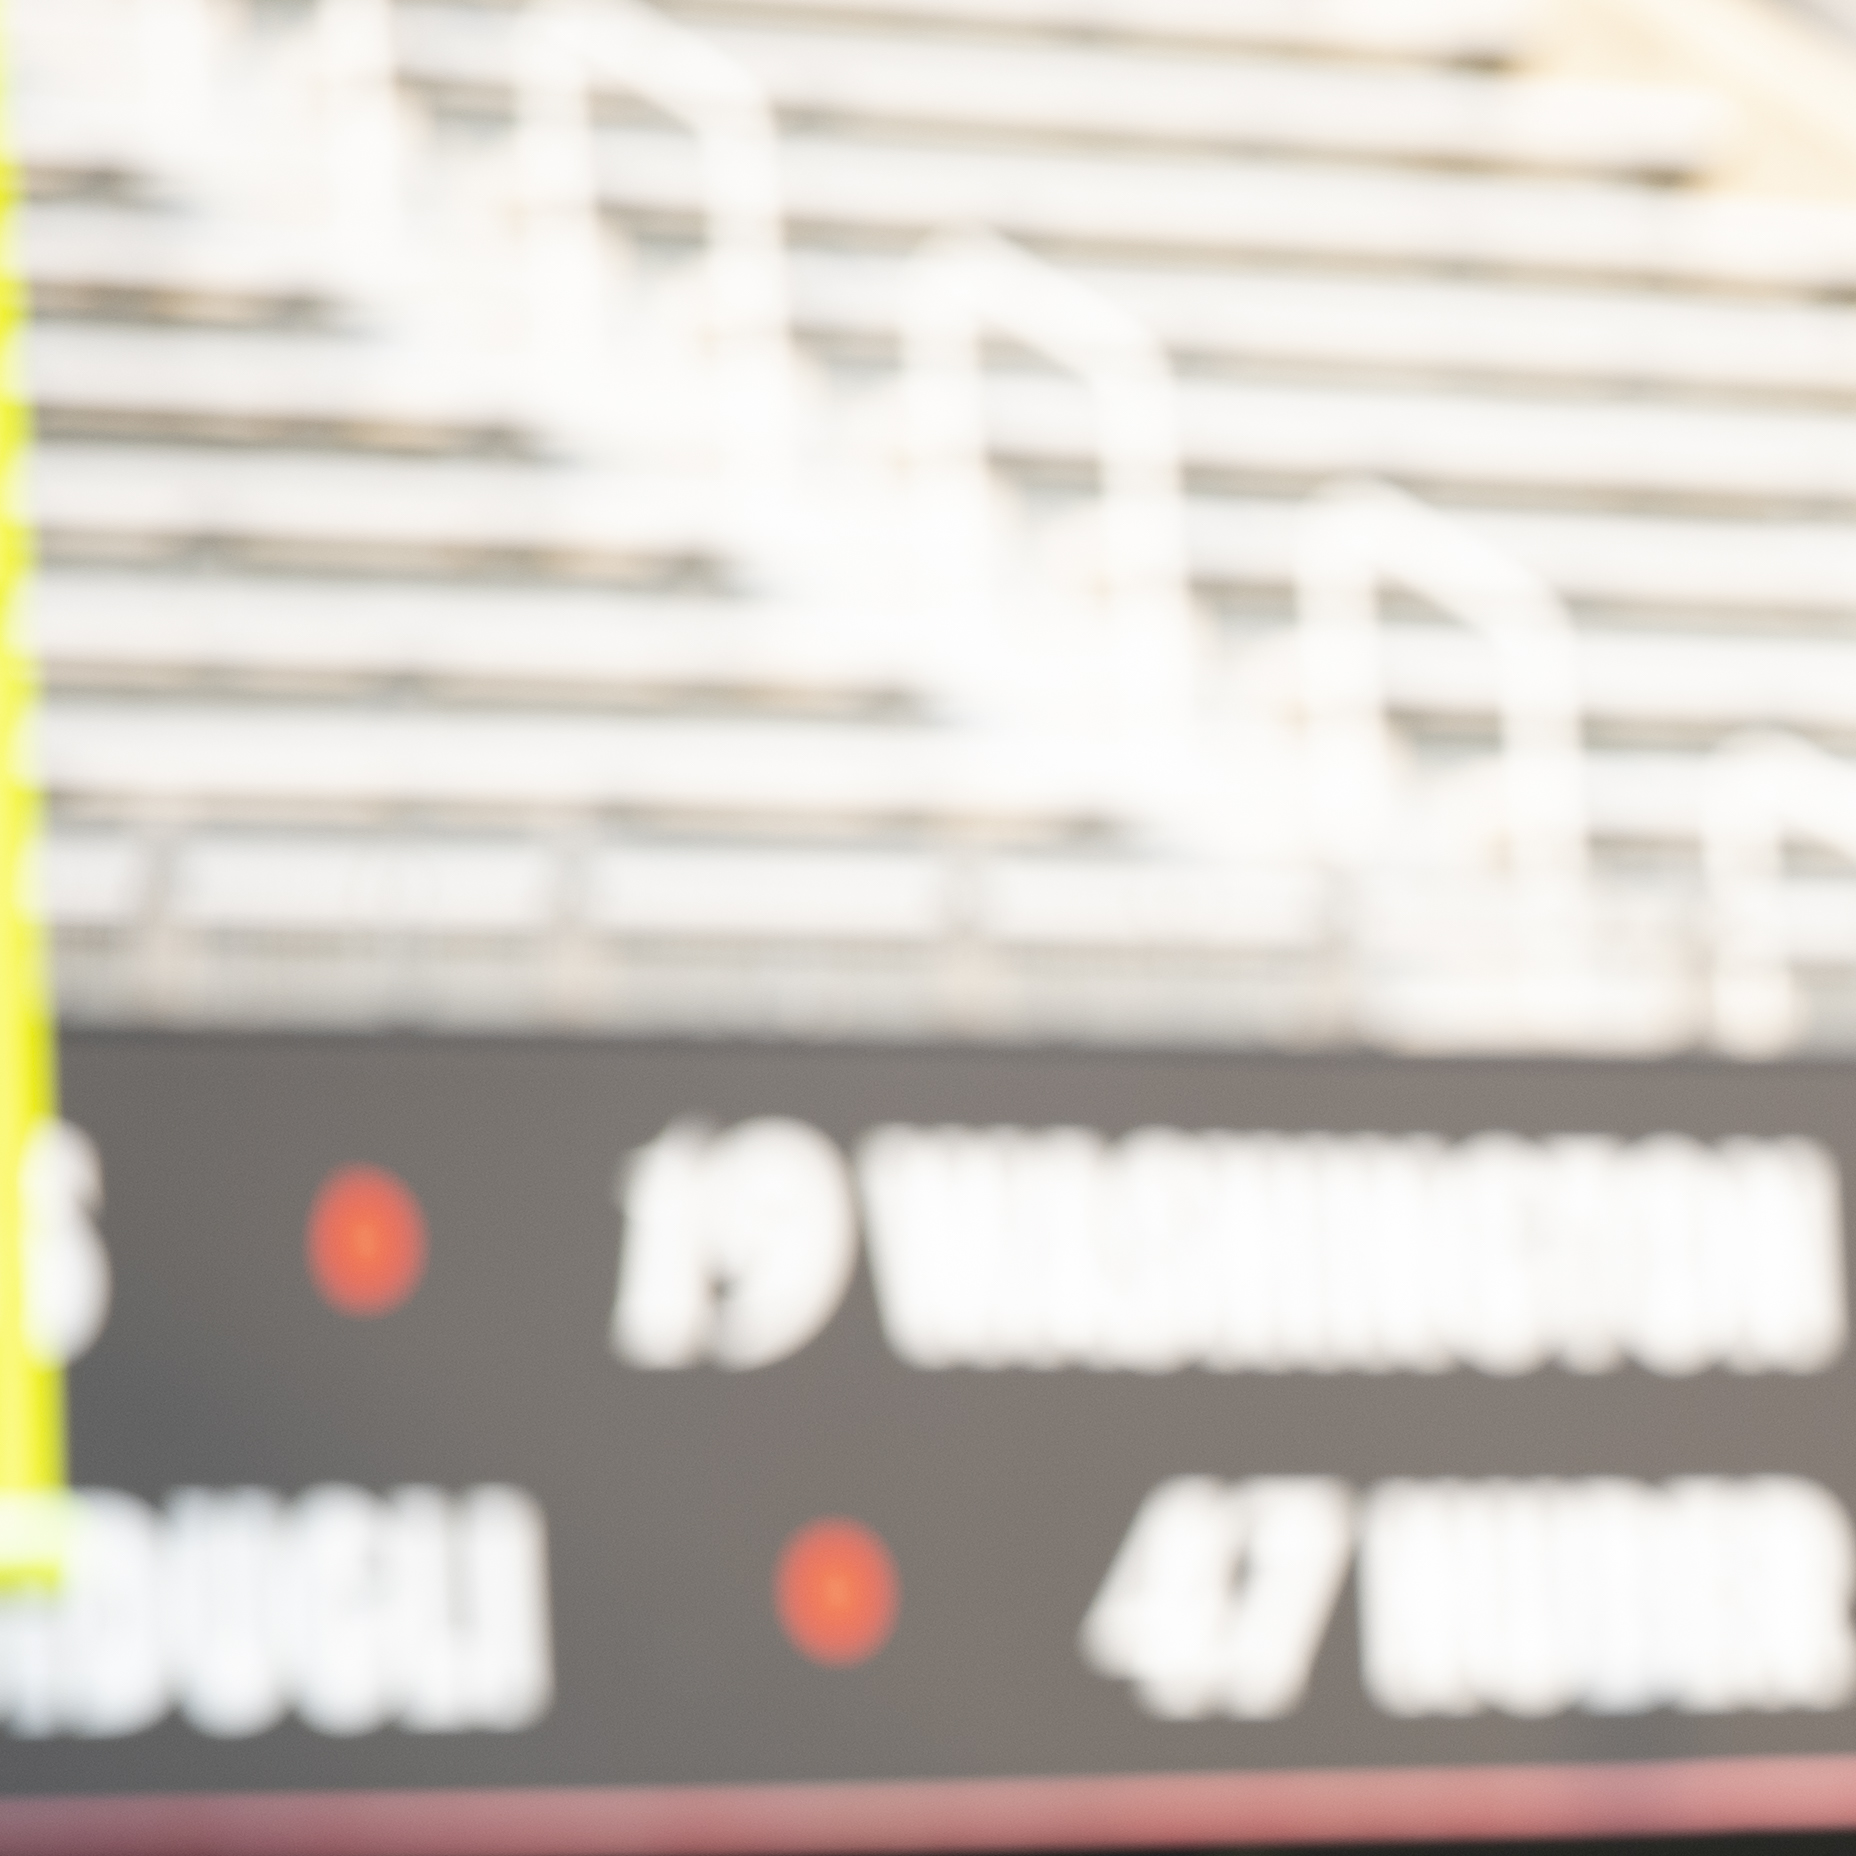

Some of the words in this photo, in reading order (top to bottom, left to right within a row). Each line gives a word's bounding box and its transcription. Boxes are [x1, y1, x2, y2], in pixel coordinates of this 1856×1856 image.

[612, 1112, 857, 1372] 19
[859, 1121, 1850, 1376] WASHINGTON
[1078, 1472, 1355, 1721] 47
